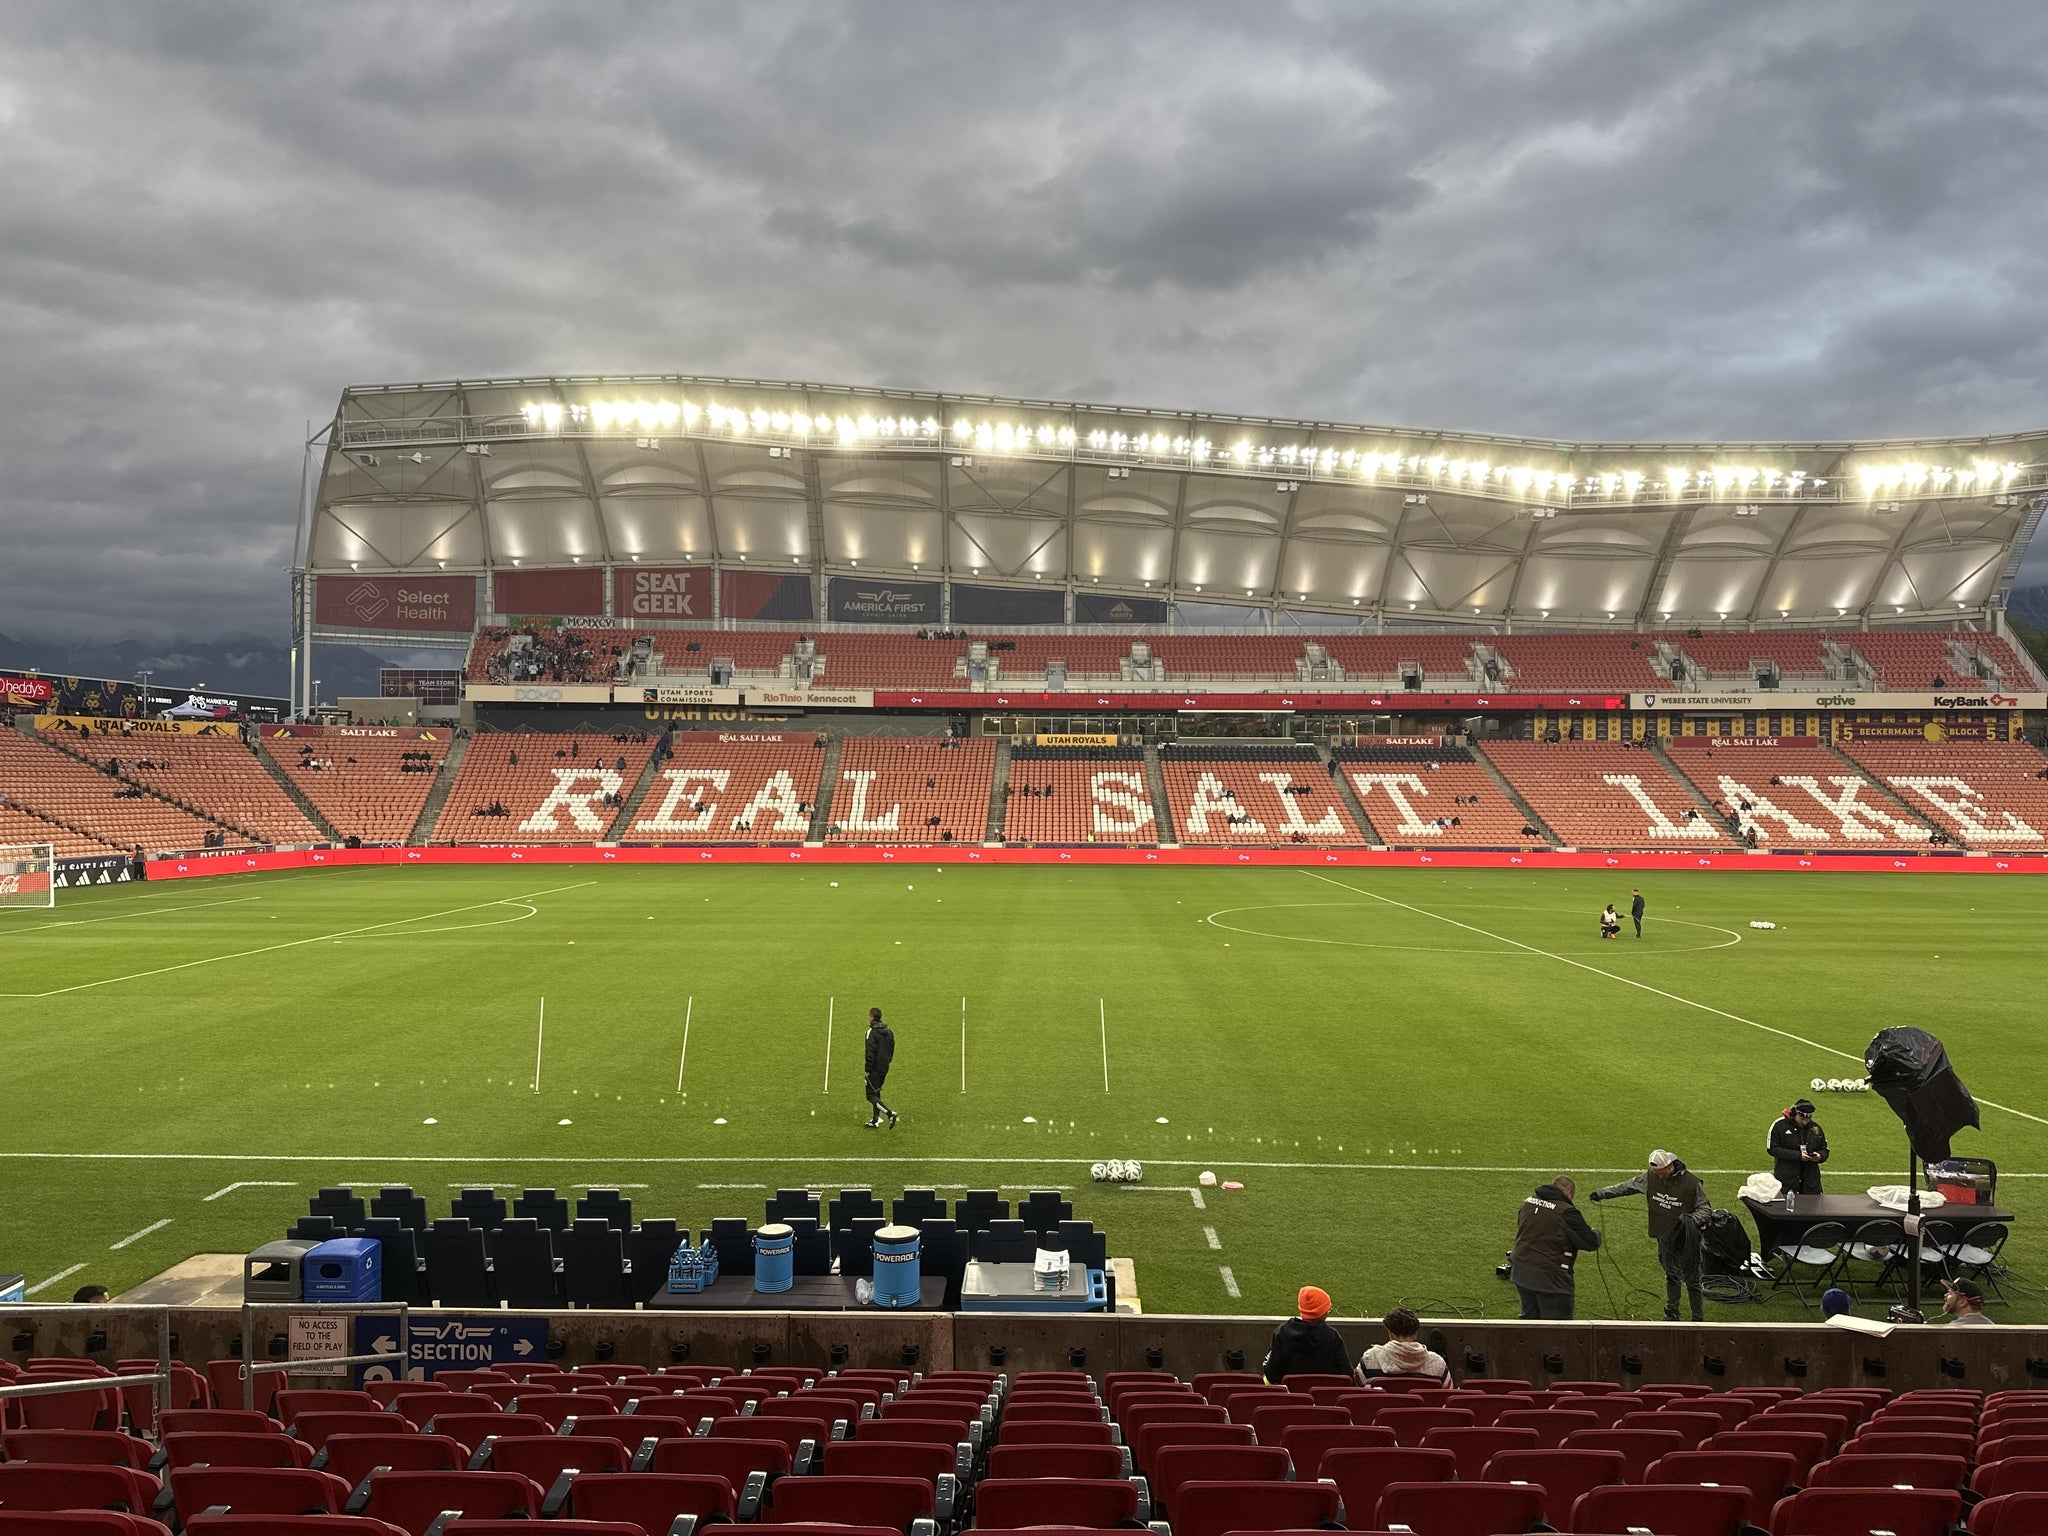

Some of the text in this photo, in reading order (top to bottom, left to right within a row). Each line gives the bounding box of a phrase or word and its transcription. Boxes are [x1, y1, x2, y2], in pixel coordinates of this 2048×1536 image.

[635, 571, 691, 593] SEAT
[397, 589, 449, 605] Select
[632, 593, 694, 615] GEEK
[843, 601, 926, 613] AMERICA FIRST
[396, 606, 447, 620] Health
[6, 680, 45, 698] beddy's
[514, 687, 563, 701] DOMO
[684, 689, 714, 697] SPORTS
[807, 693, 857, 704] Kennecott
[1816, 695, 1856, 708] aptive
[1933, 696, 1989, 709] KeyBank
[131, 721, 181, 732] ROYALS
[340, 728, 367, 736] SALT
[368, 729, 398, 737] LAKE
[739, 734, 760, 742] SALT
[761, 734, 783, 742] LAKE
[1843, 726, 1996, 741] 5 BECKERMAN'S BLOCK 5
[1047, 736, 1107, 744] UTAH ROYALS
[1733, 738, 1754, 746] SALT
[1756, 738, 1779, 746] LAKE
[518, 768, 2046, 842] REAL SALT LAKE
[759, 1246, 791, 1256] POWERADE
[876, 1252, 915, 1263] POWERADE
[298, 1321, 338, 1329] NO ACCESS
[306, 1331, 331, 1340] TO THE
[292, 1342, 343, 1351] FIELD OF PLAY
[410, 1343, 492, 1361] SECTION
